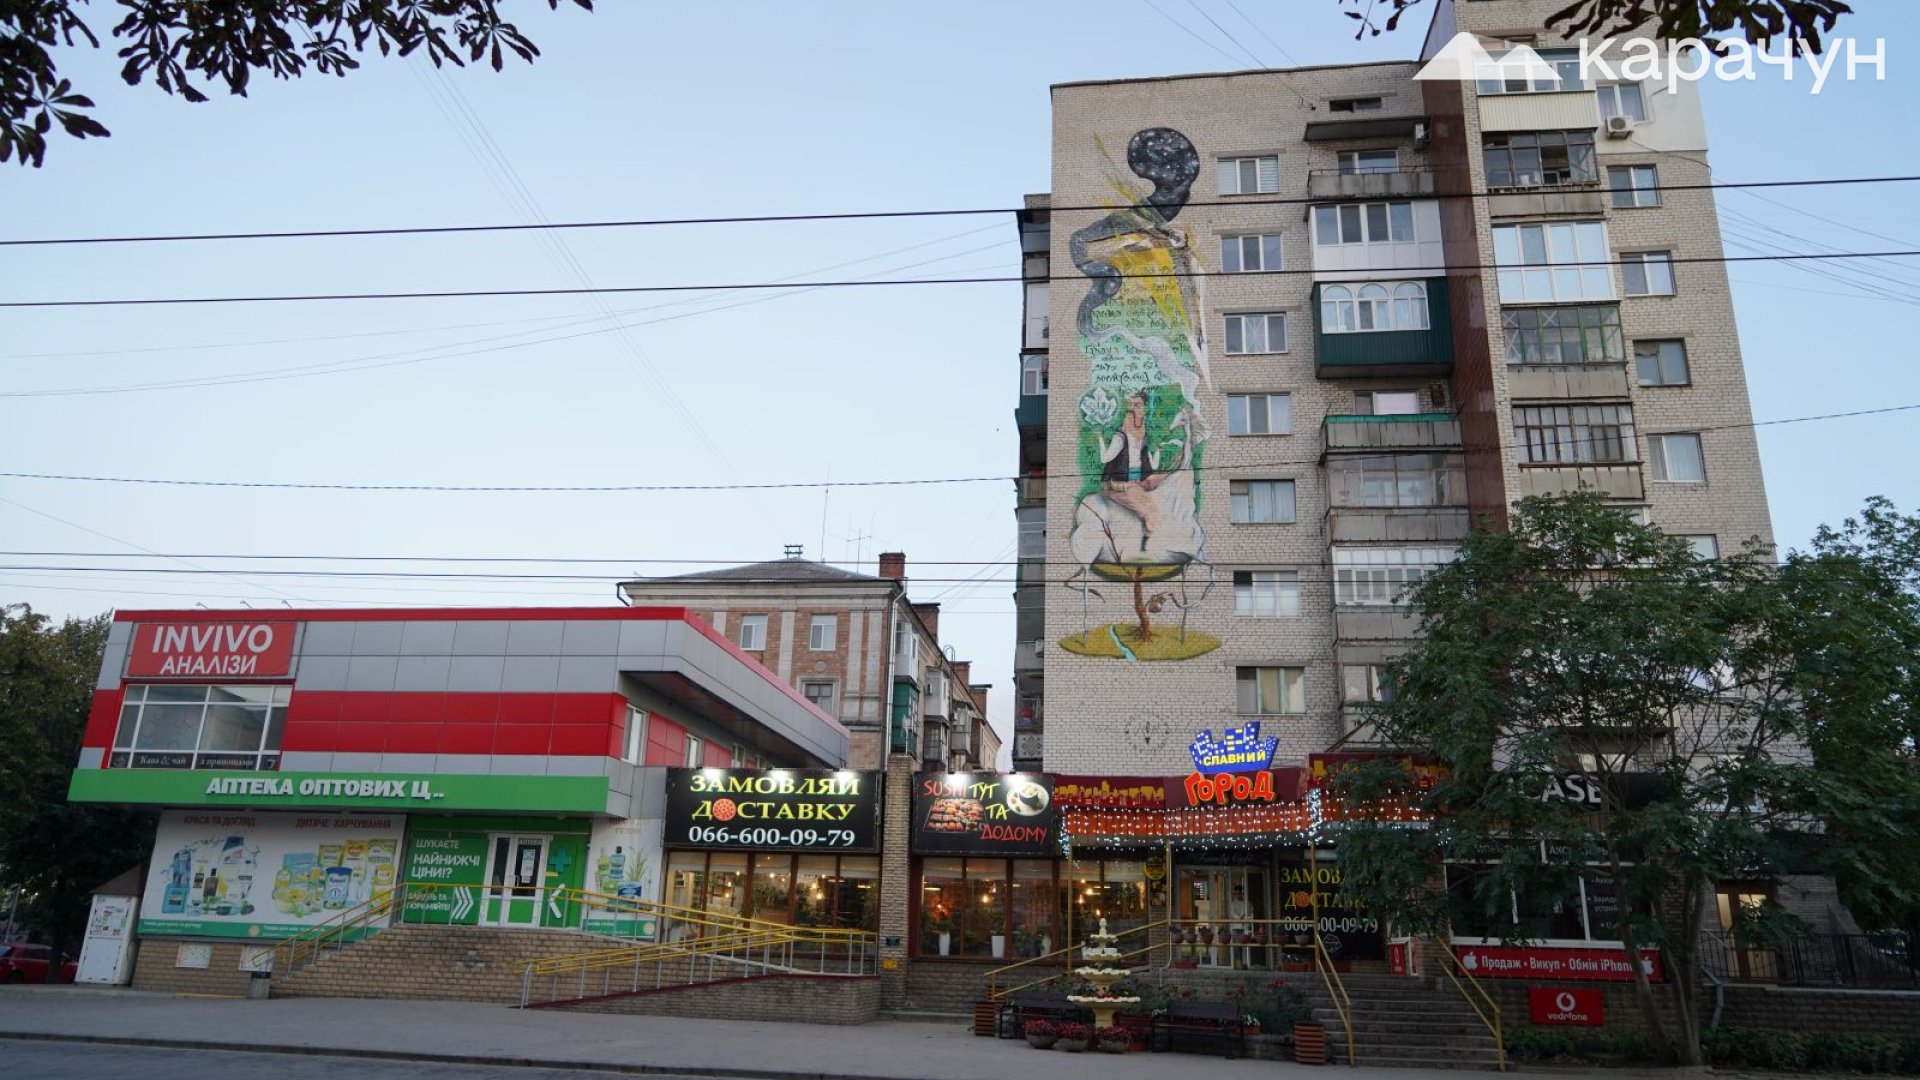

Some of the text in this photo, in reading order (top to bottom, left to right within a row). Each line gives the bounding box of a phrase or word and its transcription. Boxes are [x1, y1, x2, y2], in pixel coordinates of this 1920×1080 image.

[152, 624, 274, 653] INVIVO
[160, 655, 257, 675] АНАЛІЗИ
[1203, 750, 1266, 767] СЛАВНИЙ
[206, 777, 294, 796] АПТЕКА
[300, 778, 405, 798] ОПТОВИХ
[923, 779, 967, 797] SUSHI
[969, 782, 1000, 800] ТУТ
[1184, 771, 1275, 806] ГОРОД
[985, 803, 1010, 820] ТА
[688, 826, 855, 846] 066-600-09-79
[980, 824, 1047, 844] ДОДОМУ
[413, 851, 480, 867] НАЙНИЖЧІ
[1481, 955, 1521, 970] Продаж
[1530, 956, 1561, 973] Викуп
[1569, 957, 1598, 971] Обмін
[1547, 1012, 1589, 1021] vodafone
